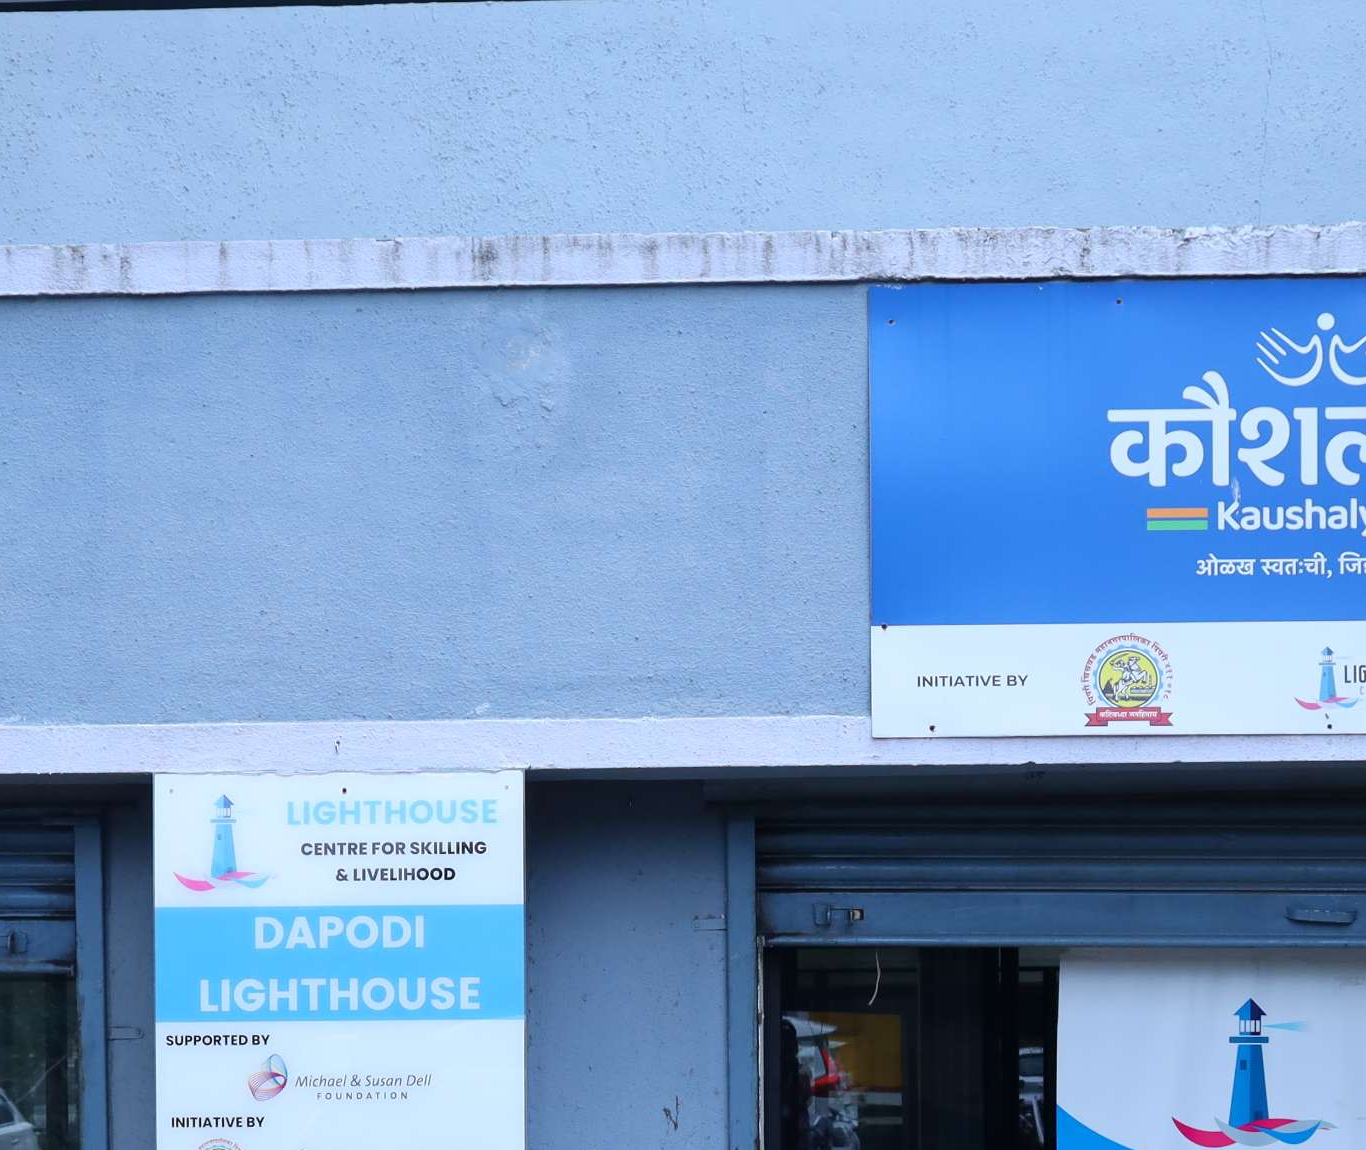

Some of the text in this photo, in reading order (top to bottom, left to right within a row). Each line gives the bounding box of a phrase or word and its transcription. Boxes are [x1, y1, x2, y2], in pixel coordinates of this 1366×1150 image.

[1196, 553, 1256, 576] ओळख
[1260, 552, 1332, 578] स्वतःची,
[918, 675, 1028, 687] INITIATIVE BY
[288, 800, 497, 825] LIGHTHOUSE
[301, 841, 487, 855] CENTRE FOR SKILLING
[336, 868, 455, 881] & LIVELIHOOD
[255, 916, 424, 949] DAPODI
[200, 976, 481, 1013] LIGHTHOUSE
[166, 1035, 270, 1046] SUPPORTED BY
[295, 1074, 431, 1087] Michael & Susan Dell
[317, 1092, 407, 1100] FOUNDATION
[172, 1117, 264, 1128] INITIATIVE BY
